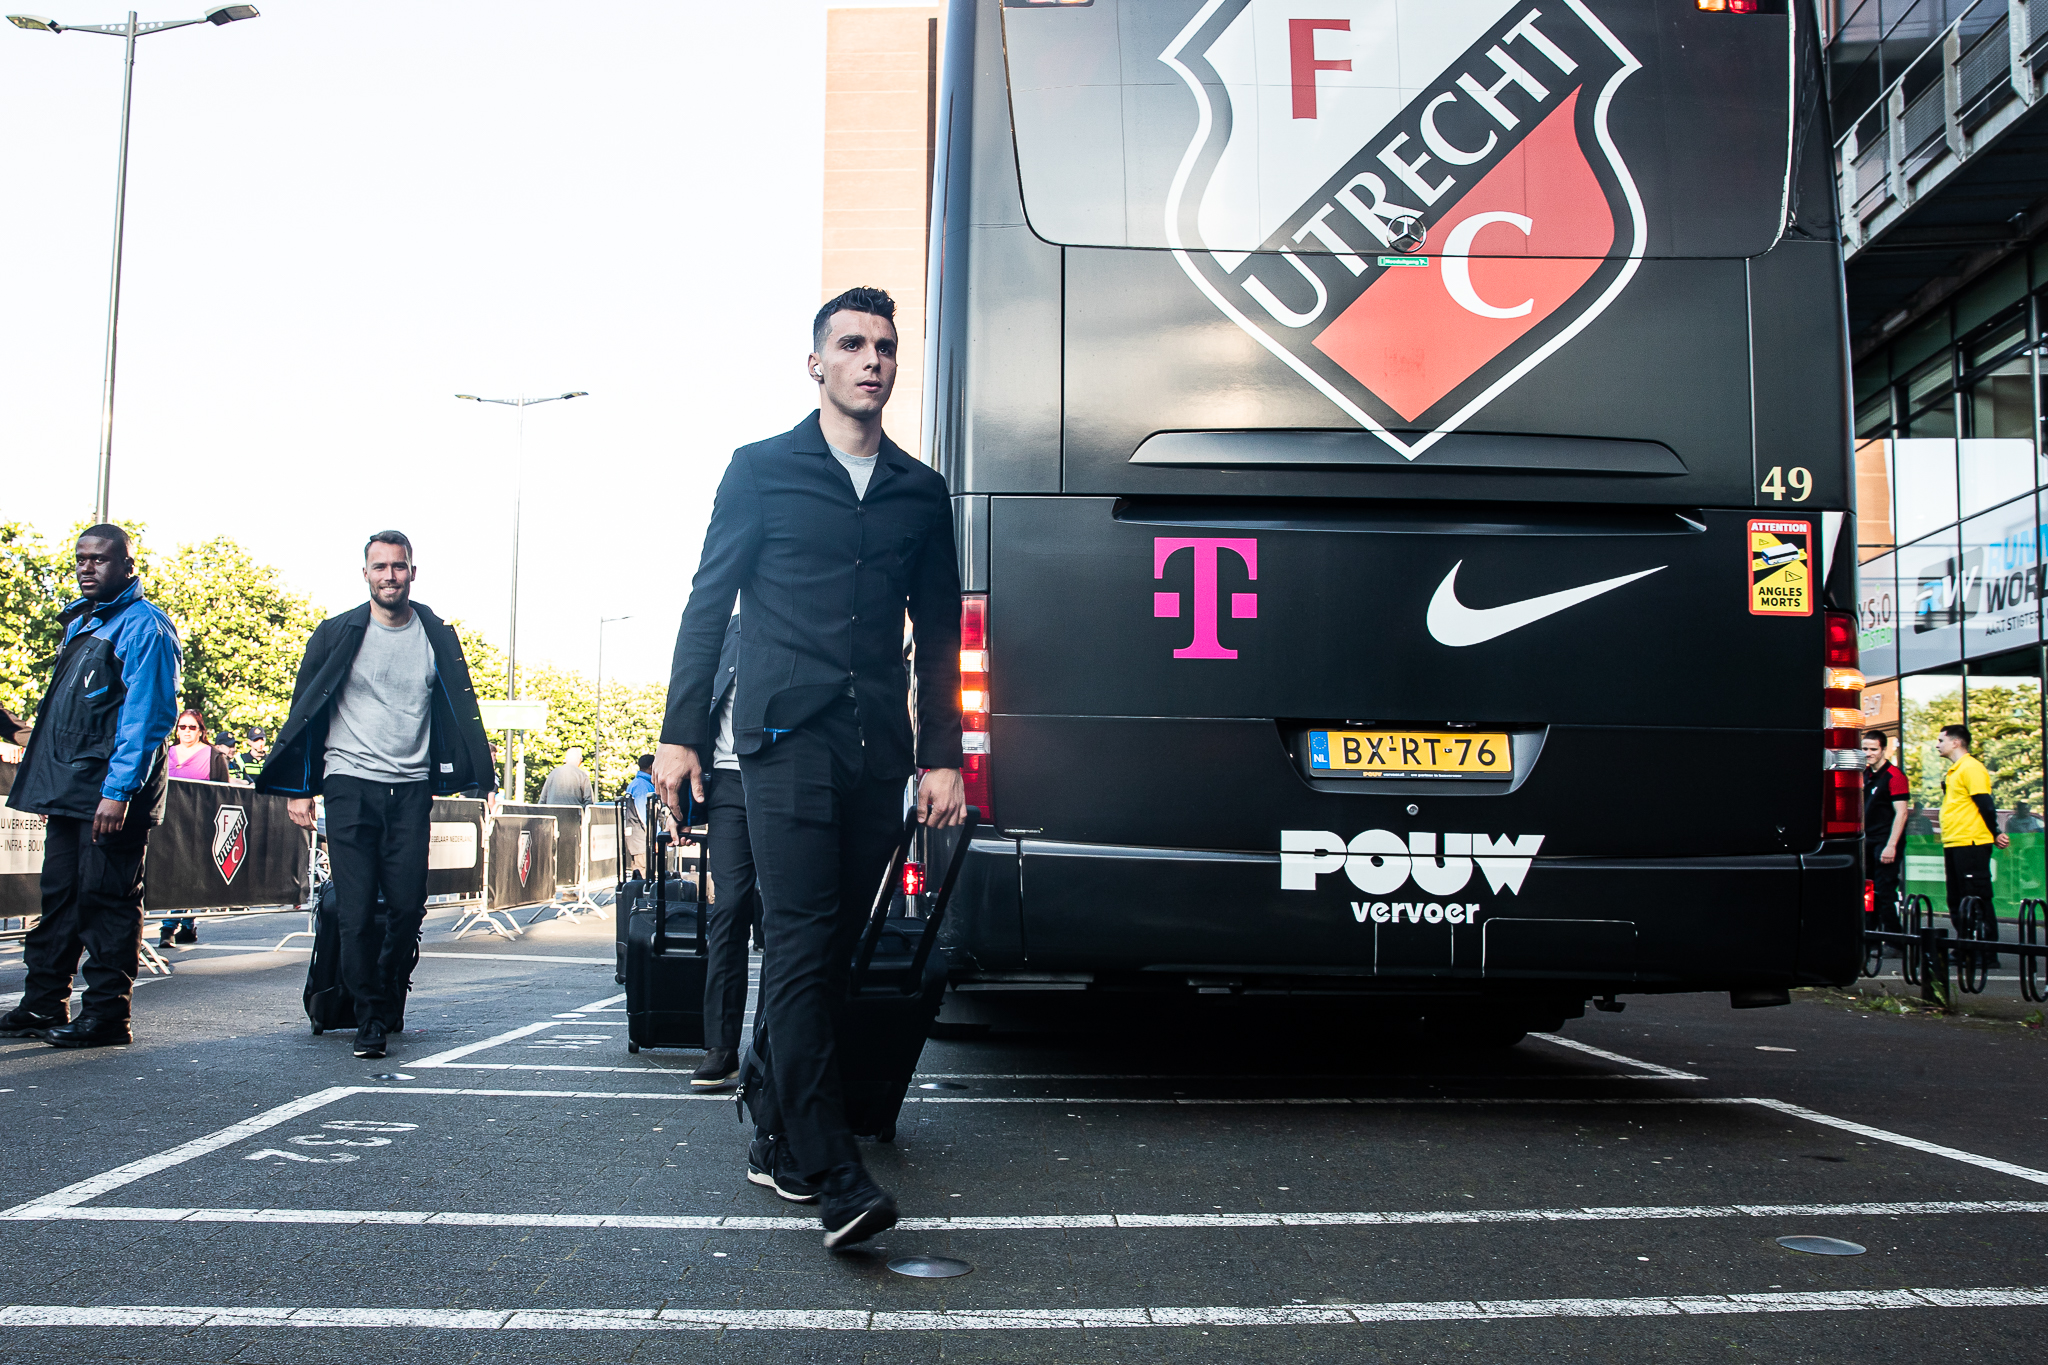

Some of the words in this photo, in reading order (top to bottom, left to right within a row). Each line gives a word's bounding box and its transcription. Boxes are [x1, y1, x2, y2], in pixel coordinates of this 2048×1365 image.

[1288, 19, 1353, 120] F
[1240, 8, 1579, 328] UTRECHT
[1440, 210, 1535, 319] C
[1760, 466, 1813, 502] 49
[1751, 522, 1807, 533] ATTENTION
[1758, 586, 1803, 597] ANGLES
[1760, 597, 1801, 607] MORTS
[1313, 753, 1328, 763] NL
[4, 839, 22, 851] INFRA
[217, 813, 244, 866] UTRECHT
[1280, 828, 1546, 896] POUW
[1350, 901, 1480, 924] vervoer
